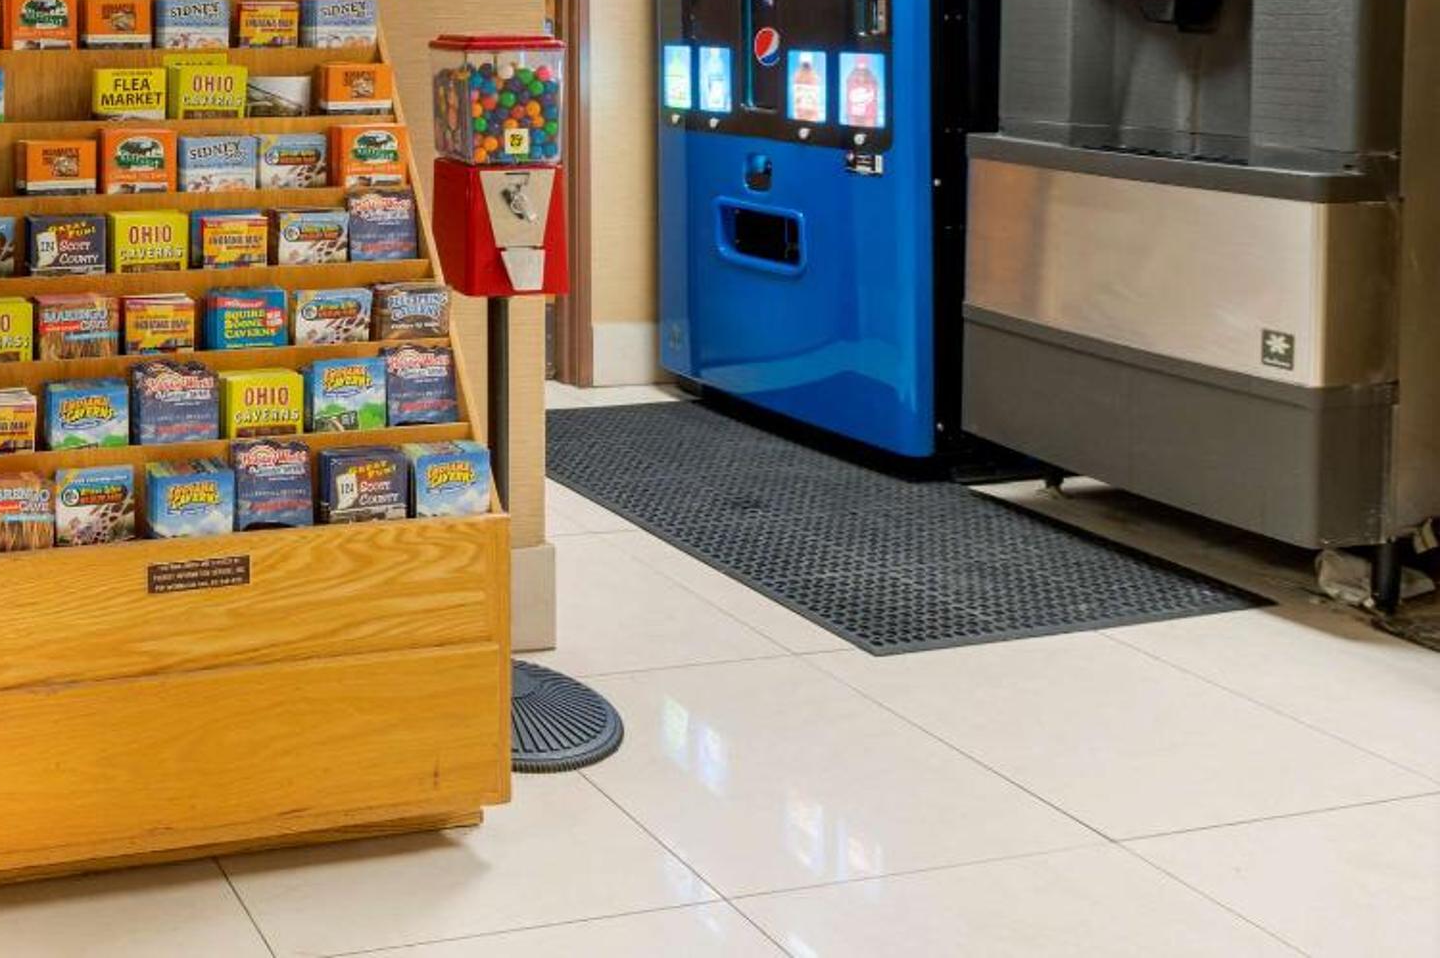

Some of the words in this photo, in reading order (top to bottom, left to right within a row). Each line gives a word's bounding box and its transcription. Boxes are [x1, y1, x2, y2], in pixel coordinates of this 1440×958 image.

[114, 78, 151, 91] FLEA
[192, 75, 233, 93] OHIO
[101, 92, 162, 105] MARKET
[190, 140, 242, 159] SIDNEY
[129, 225, 172, 245] OHIO
[40, 240, 54, 252] IN
[245, 385, 289, 406] OHIO
[235, 410, 299, 424] CAVERNS
